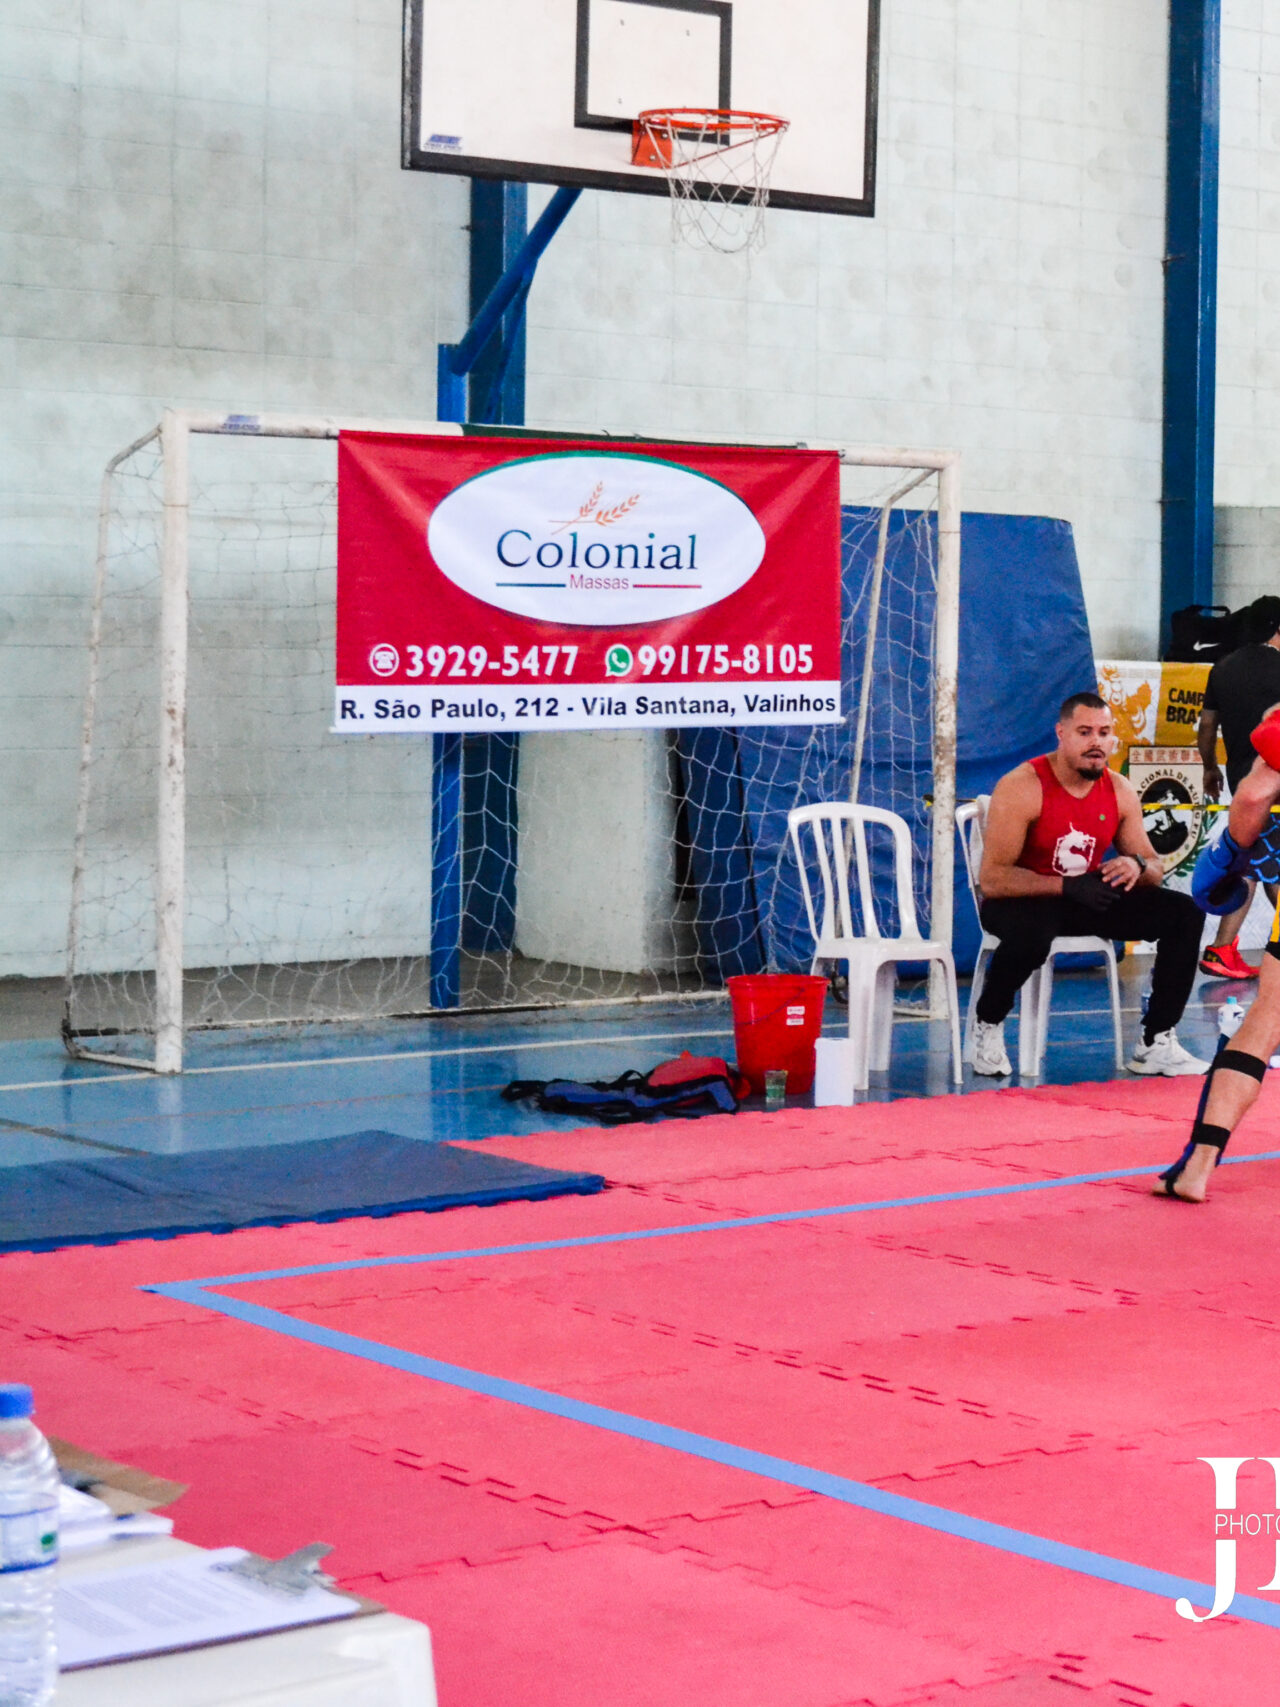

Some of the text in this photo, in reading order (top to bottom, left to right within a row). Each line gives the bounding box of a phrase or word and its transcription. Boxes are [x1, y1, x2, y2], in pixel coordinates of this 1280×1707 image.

[496, 529, 697, 570] Colonial
[570, 573, 629, 590] Massas
[406, 645, 579, 677] 3929-5477
[640, 644, 814, 676] 99175-8105
[341, 699, 364, 719] R.
[374, 699, 421, 719] São
[431, 698, 506, 721] Paulo,
[515, 697, 559, 717] 212
[582, 696, 627, 716] Vila
[635, 696, 736, 716] Santana,
[744, 694, 836, 712] Valinhos
[1136, 768, 1174, 797] ACIONAL
